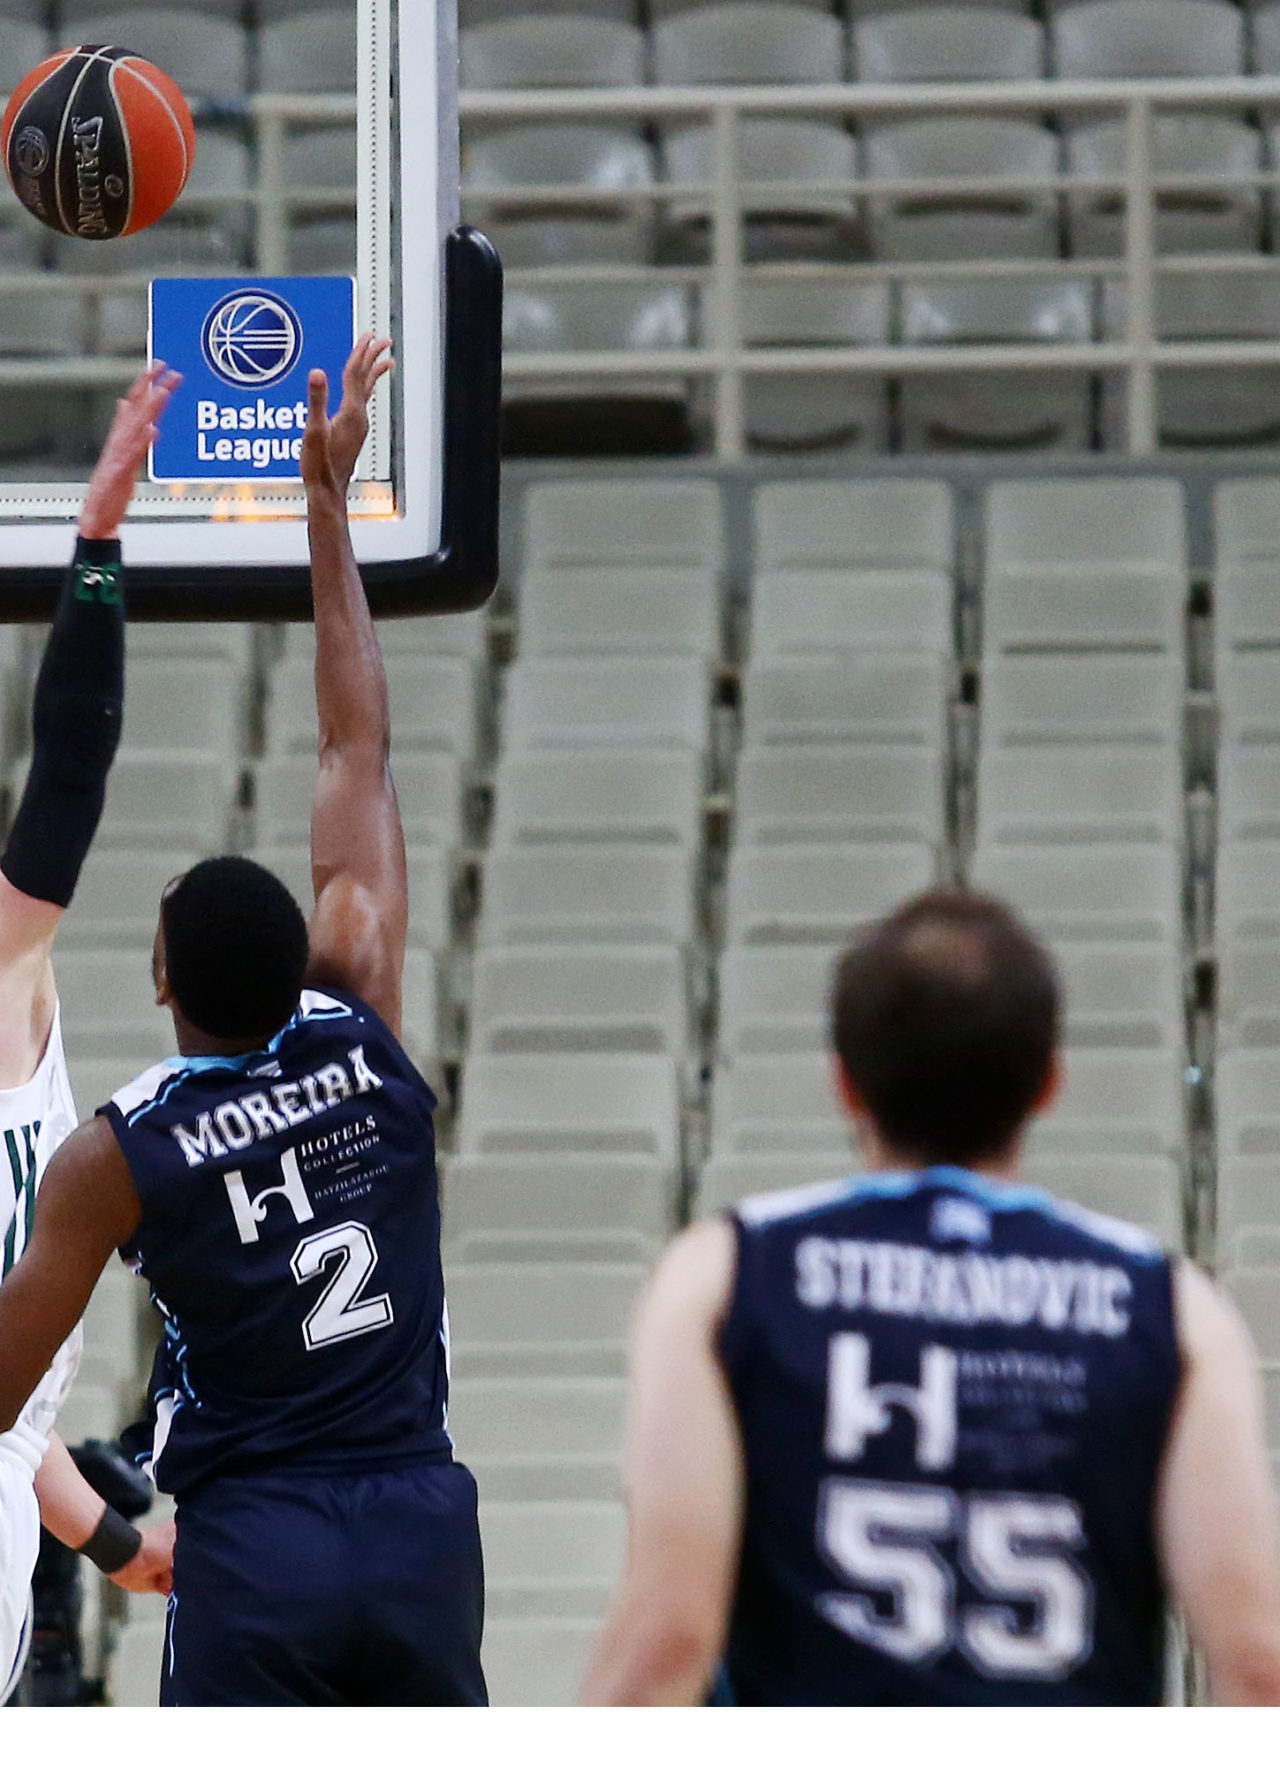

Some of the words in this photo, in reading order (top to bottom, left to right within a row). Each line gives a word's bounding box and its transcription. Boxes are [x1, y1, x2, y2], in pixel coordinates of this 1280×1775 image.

[197, 398, 308, 430] Basket
[170, 1045, 384, 1168] MOREIRA
[301, 1114, 376, 1157] HOTELS
[303, 1133, 380, 1171] COLLECTION
[289, 1220, 394, 1351] 2
[795, 1236, 1133, 1338] STEFANOVIC
[815, 1474, 1095, 1682] 55
